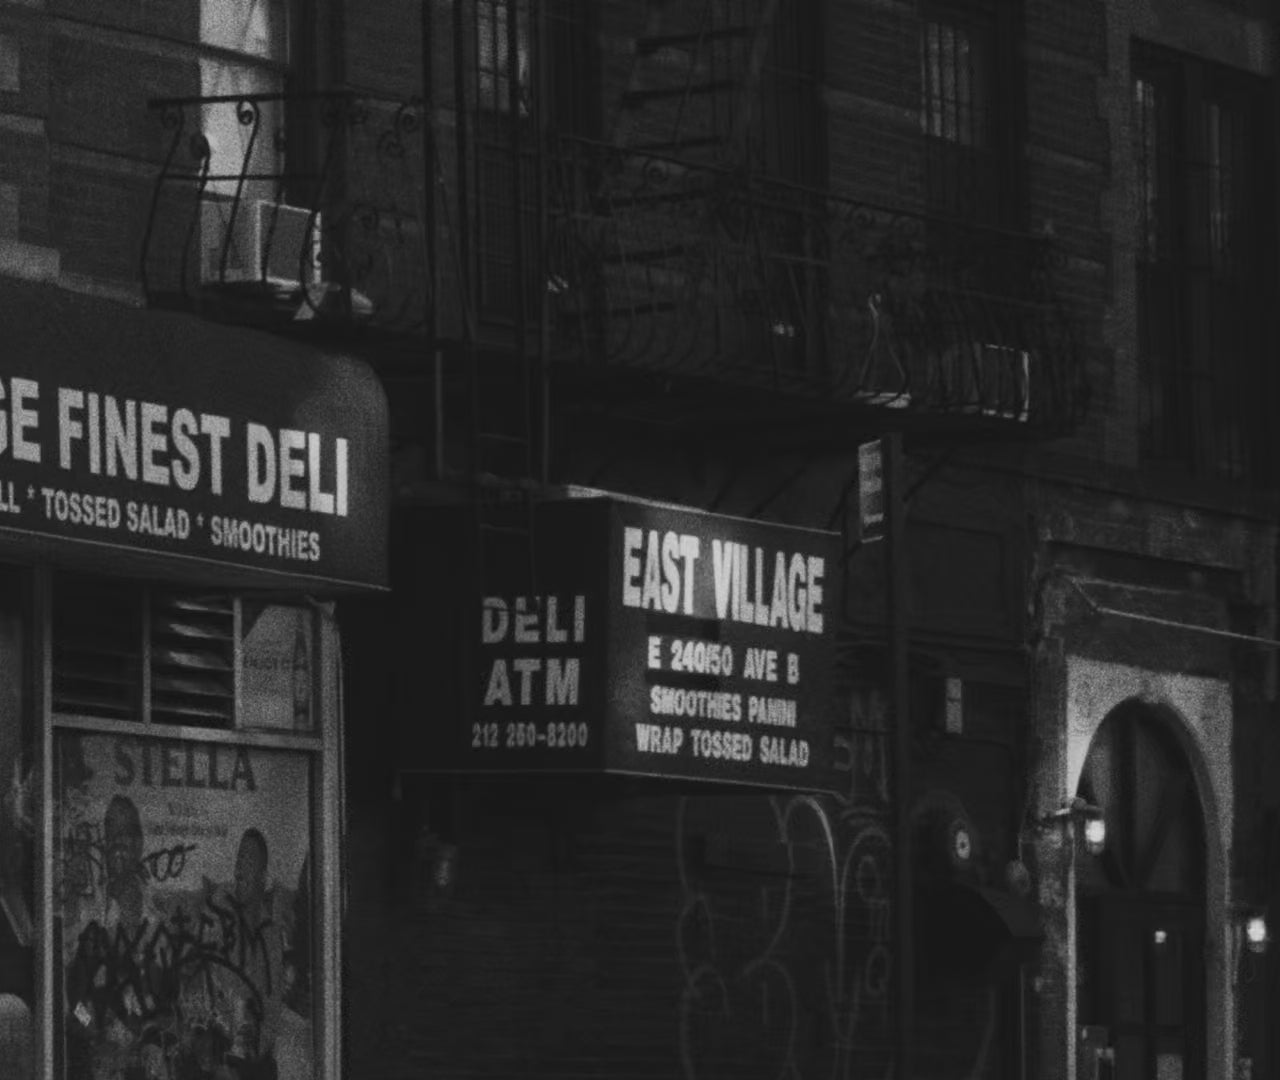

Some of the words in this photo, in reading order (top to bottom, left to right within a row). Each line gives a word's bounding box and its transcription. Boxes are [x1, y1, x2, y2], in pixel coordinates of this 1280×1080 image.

[57, 386, 232, 497] FINEST
[246, 421, 350, 517] DELI
[41, 487, 121, 533] TOSSED
[125, 501, 190, 541] SALAD
[209, 515, 322, 562] SMOOTHIES
[622, 526, 701, 616] EAST
[711, 538, 826, 635] VILLAGE
[482, 595, 586, 645] DELI
[483, 657, 581, 707] ATM
[648, 634, 662, 670] E
[743, 646, 779, 683] AVE
[787, 652, 801, 685] B
[649, 685, 742, 723] SMOOTHIES
[747, 695, 798, 729] PANINI
[471, 721, 499, 749] 212
[506, 721, 589, 749] 260-8200
[635, 722, 684, 756] WRAP
[690, 728, 753, 763] TOSSED
[759, 736, 811, 768] SALAD
[113, 747, 257, 792] STELLA
